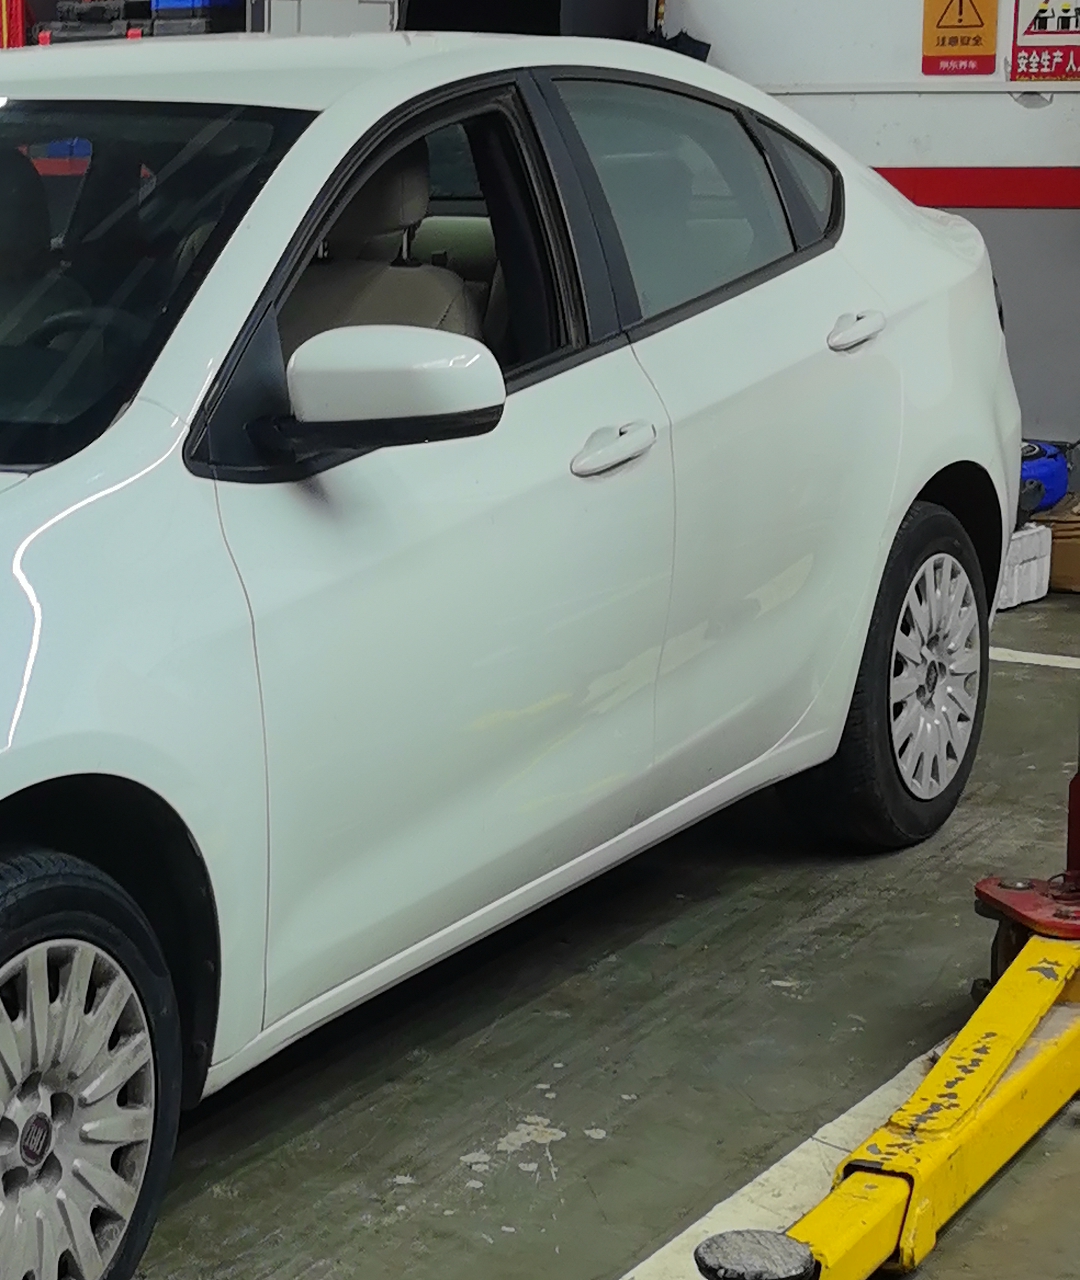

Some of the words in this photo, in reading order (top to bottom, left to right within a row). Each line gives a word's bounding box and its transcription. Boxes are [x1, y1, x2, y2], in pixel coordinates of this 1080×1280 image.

[1017, 50, 1080, 73] 安全生产人
